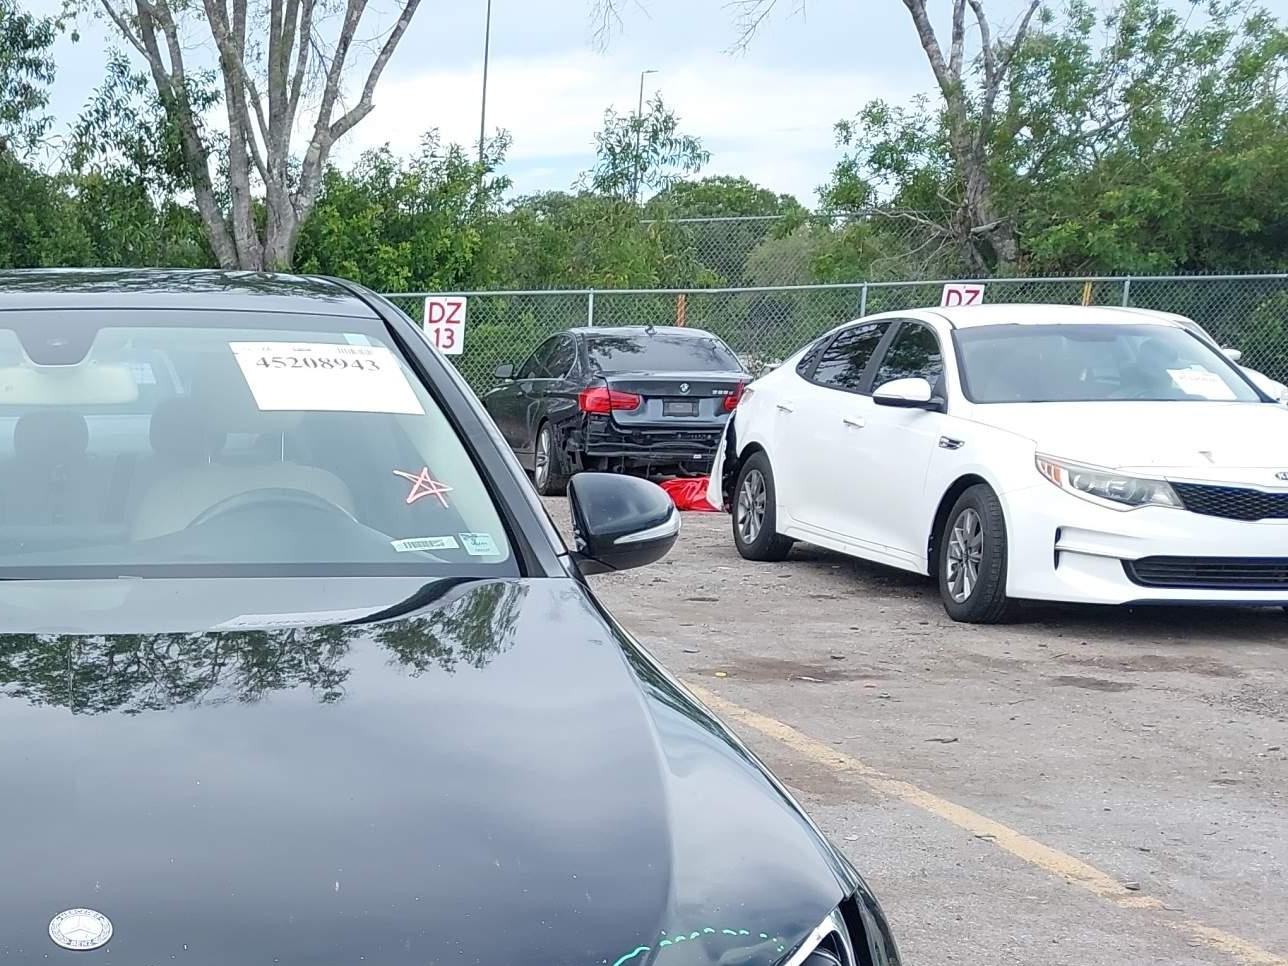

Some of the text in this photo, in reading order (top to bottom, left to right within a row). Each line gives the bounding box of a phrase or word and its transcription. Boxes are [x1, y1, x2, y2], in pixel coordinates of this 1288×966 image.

[945, 289, 980, 306] DZ
[428, 301, 463, 324] DZ
[433, 327, 455, 349] 13
[255, 355, 381, 372] 45208943
